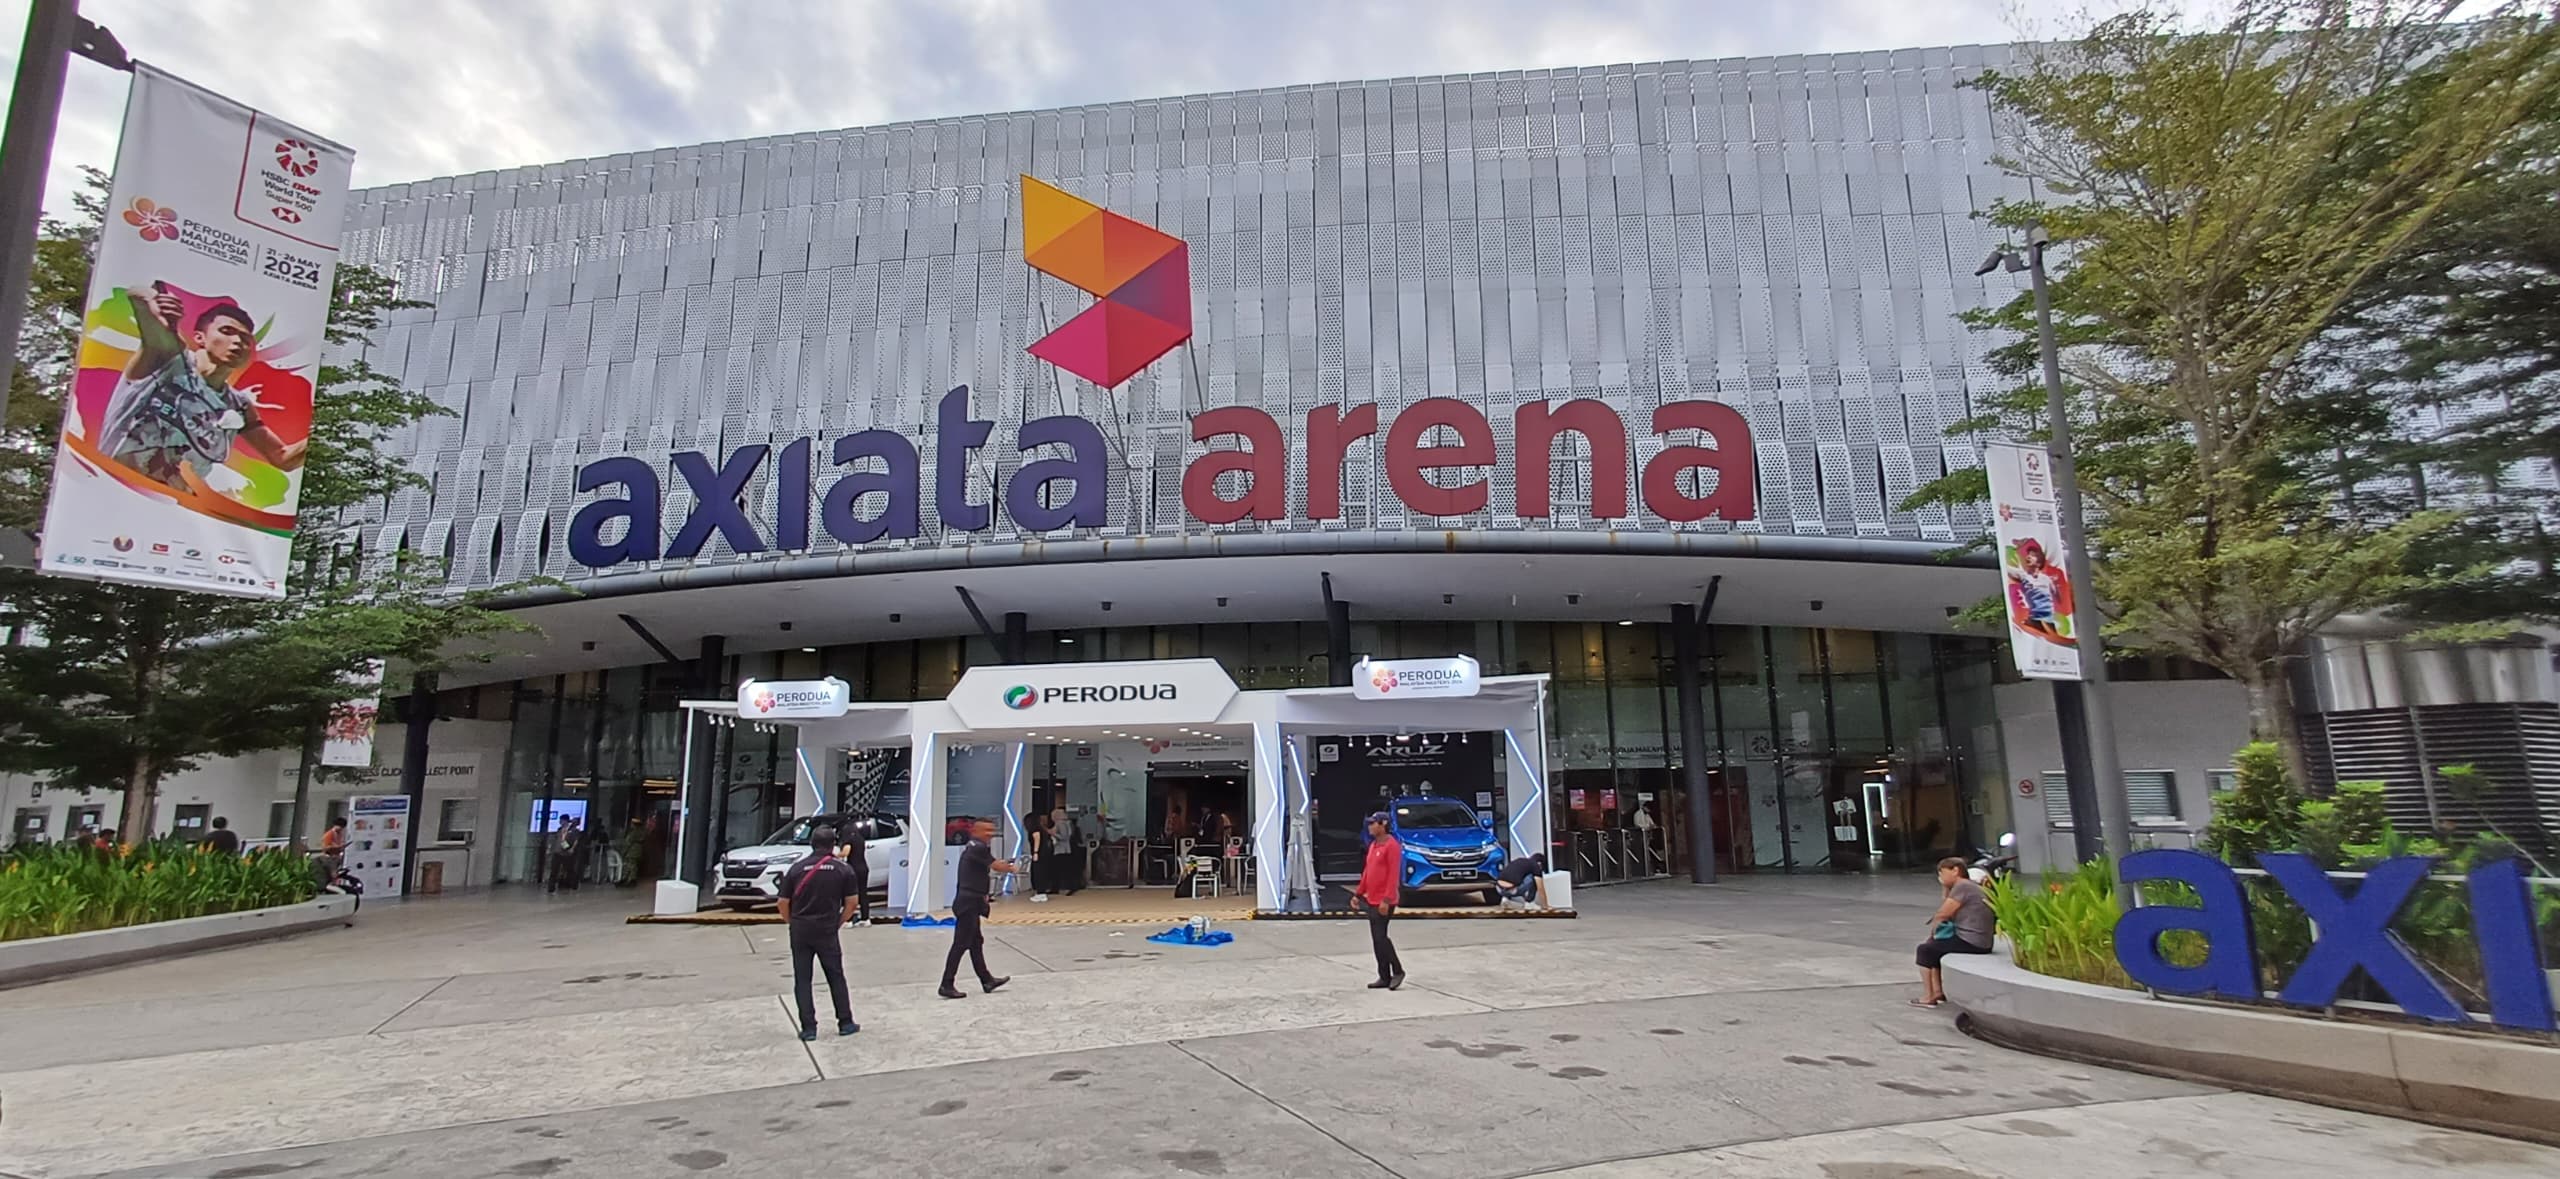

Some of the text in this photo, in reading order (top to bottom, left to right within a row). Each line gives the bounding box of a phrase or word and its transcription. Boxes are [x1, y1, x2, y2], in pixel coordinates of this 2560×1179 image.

[261, 169, 290, 186] HSBC
[264, 180, 317, 205] World Tour
[265, 189, 313, 213] Super 500
[181, 229, 249, 257] MALAYSIA
[183, 219, 251, 249] PERODUA
[180, 238, 228, 259] MASTERS
[267, 248, 277, 256] 21
[284, 253, 296, 262] 26
[297, 257, 322, 270] MAY
[263, 271, 318, 291] AXIATA ARENA
[264, 256, 320, 284] 2024
[568, 384, 1755, 568] axiata arena
[1399, 670, 1461, 681] PERODUA
[777, 691, 831, 702] PERODUA
[1366, 744, 1445, 757] ARUZ
